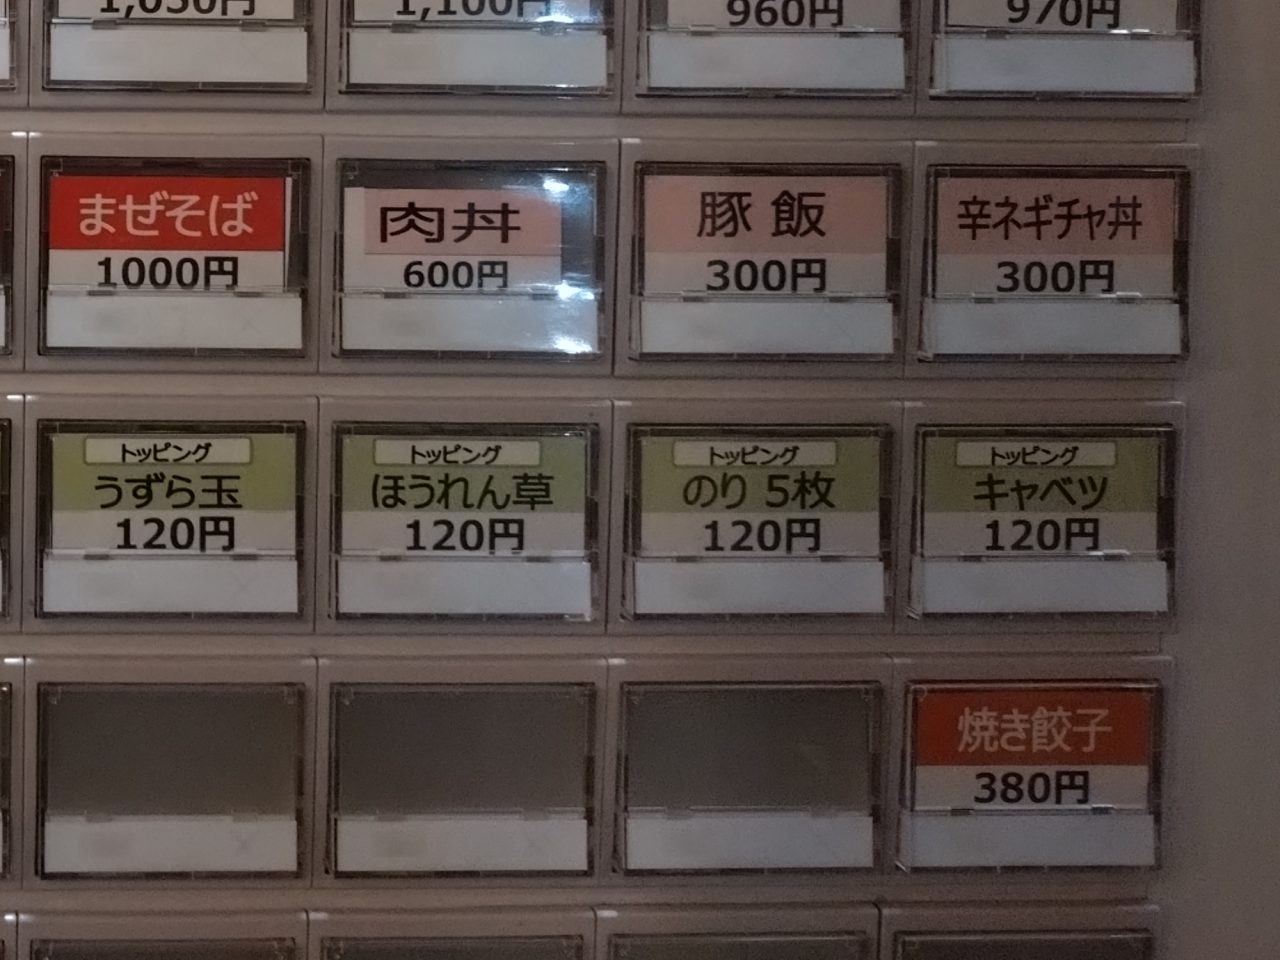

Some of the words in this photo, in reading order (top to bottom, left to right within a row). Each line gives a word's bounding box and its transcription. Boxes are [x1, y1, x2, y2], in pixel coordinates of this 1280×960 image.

[79, 191, 259, 238] まぜそば
[379, 201, 521, 244] 肉丼
[697, 190, 827, 239] 豚飯
[957, 194, 1142, 240] 辛ネギチャ丼
[98, 256, 240, 290] 1000円
[403, 260, 509, 290] 600円
[706, 258, 827, 292] 300円
[996, 260, 1115, 294] 300円
[120, 443, 212, 464] トッピング
[410, 444, 502, 465] トッピング
[709, 445, 800, 466] トッピング
[991, 446, 1079, 466] トッピング
[94, 473, 242, 511] うずら玉
[372, 473, 554, 511] ほうれん草
[683, 474, 747, 509] のり
[766, 471, 836, 509] 5枚
[973, 473, 1109, 512] キャベツ
[117, 517, 235, 551] 120円
[406, 518, 525, 554] 120円
[703, 519, 821, 554] 120円
[985, 518, 1100, 552] 120円
[958, 706, 1112, 753] 焼き餃子
[974, 771, 1090, 804] 380円
